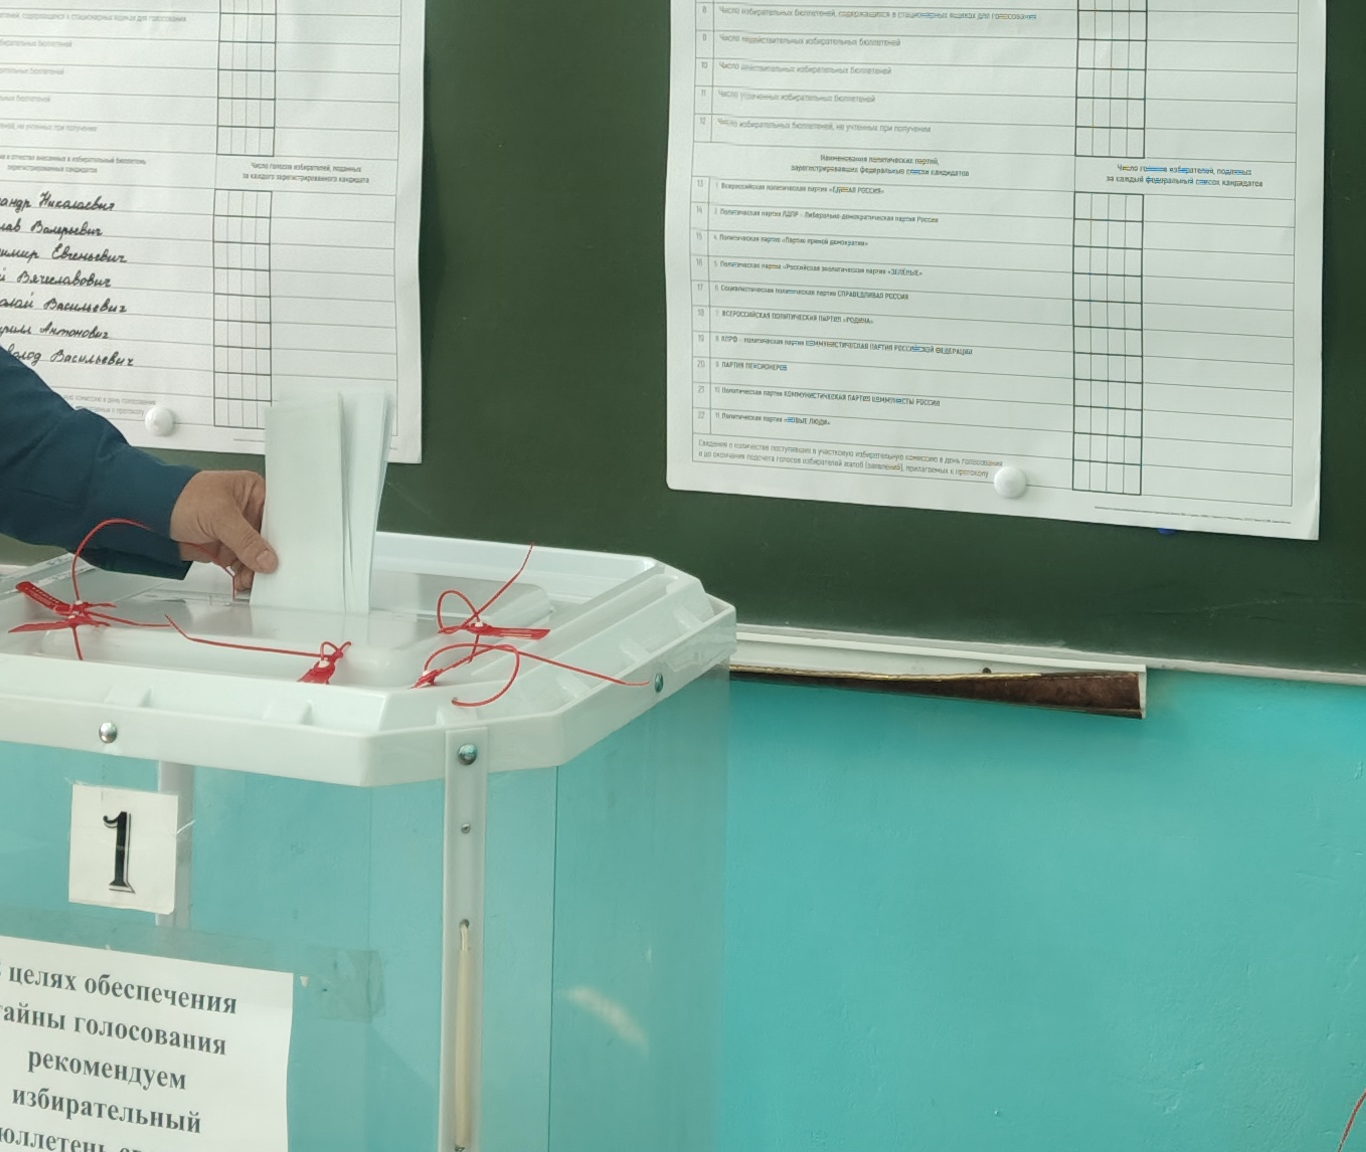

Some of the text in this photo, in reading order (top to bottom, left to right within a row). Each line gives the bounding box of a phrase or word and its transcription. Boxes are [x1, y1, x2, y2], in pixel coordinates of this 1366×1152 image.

[103, 811, 136, 894] 1
[9, 965, 77, 991] целях
[84, 974, 237, 1014] обеспечения
[74, 1016, 226, 1056] голосования
[27, 1049, 185, 1091] рекомендуем
[13, 1088, 201, 1134] избирательный
